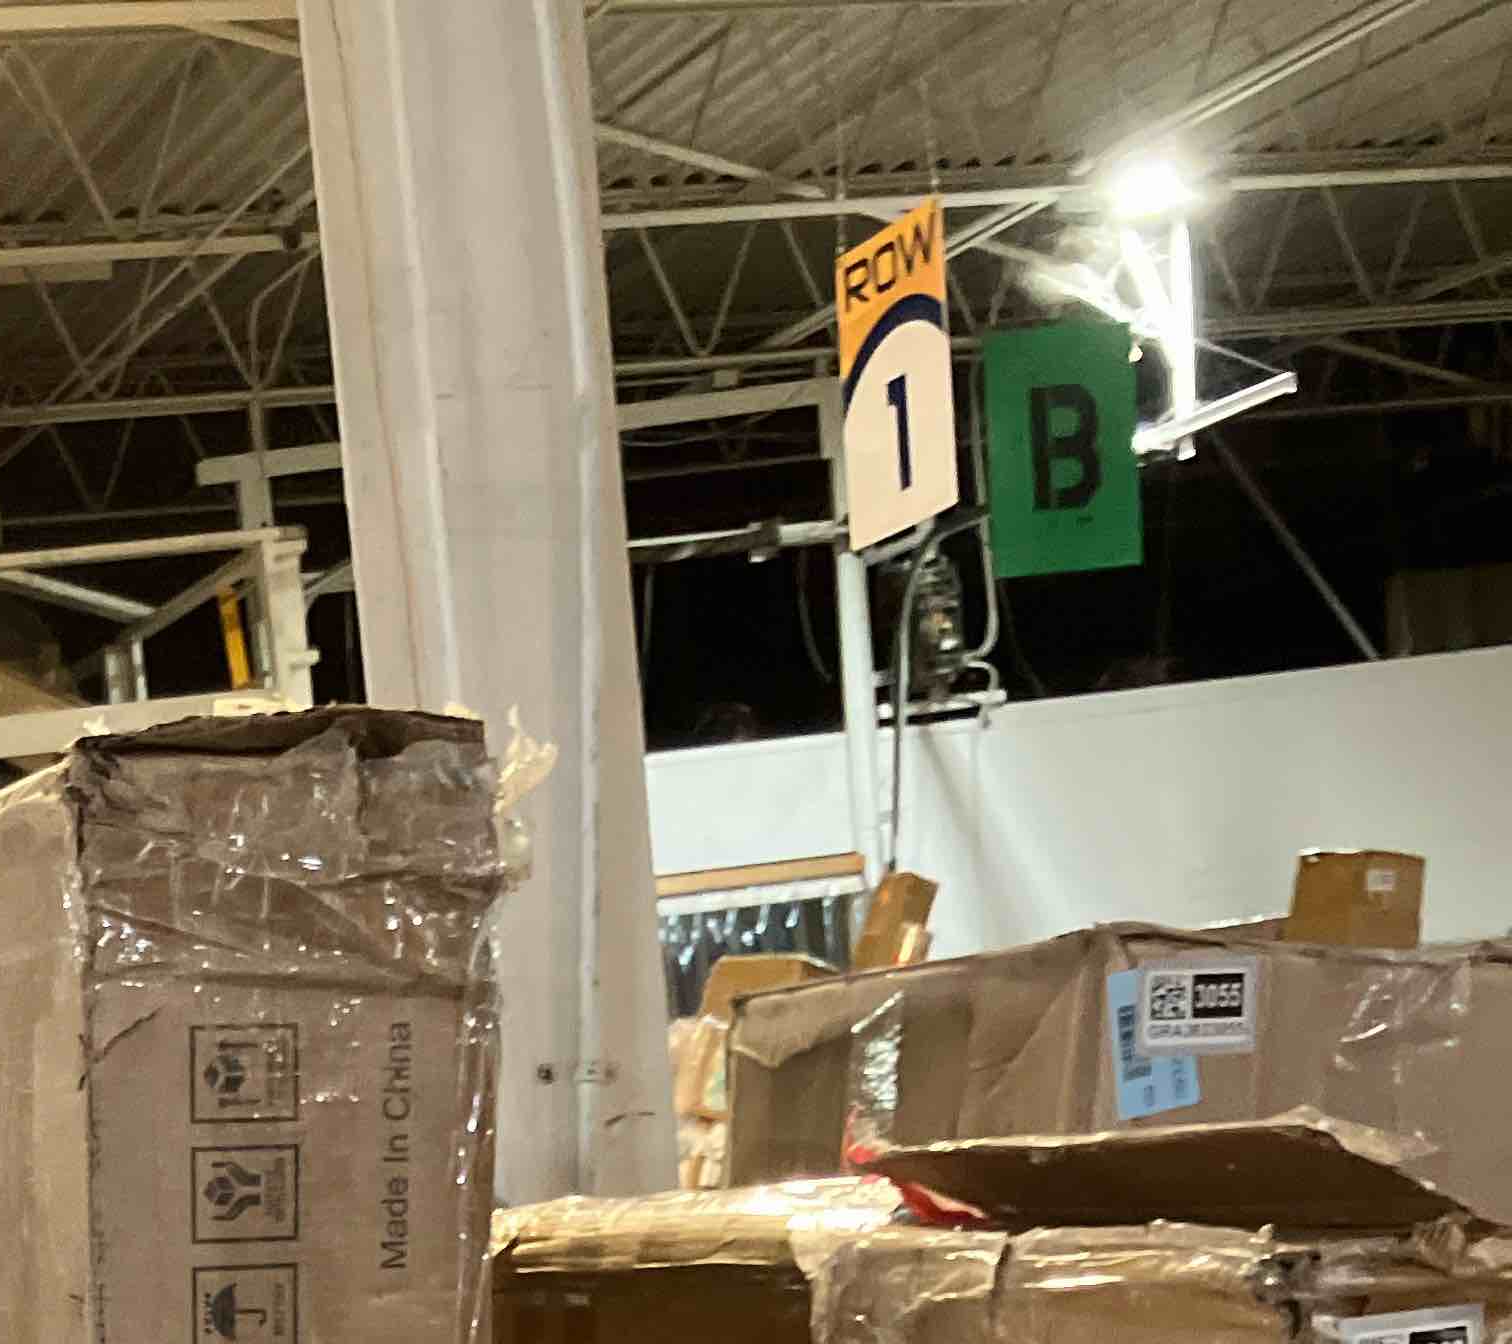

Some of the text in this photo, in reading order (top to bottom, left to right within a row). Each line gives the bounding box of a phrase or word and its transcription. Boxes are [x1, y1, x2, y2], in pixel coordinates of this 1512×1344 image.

[842, 208, 937, 313] ROW
[885, 374, 912, 491] 1
[1029, 383, 1102, 512] B
[1193, 983, 1243, 1010] 3055
[380, 1021, 413, 1271] Made In China
